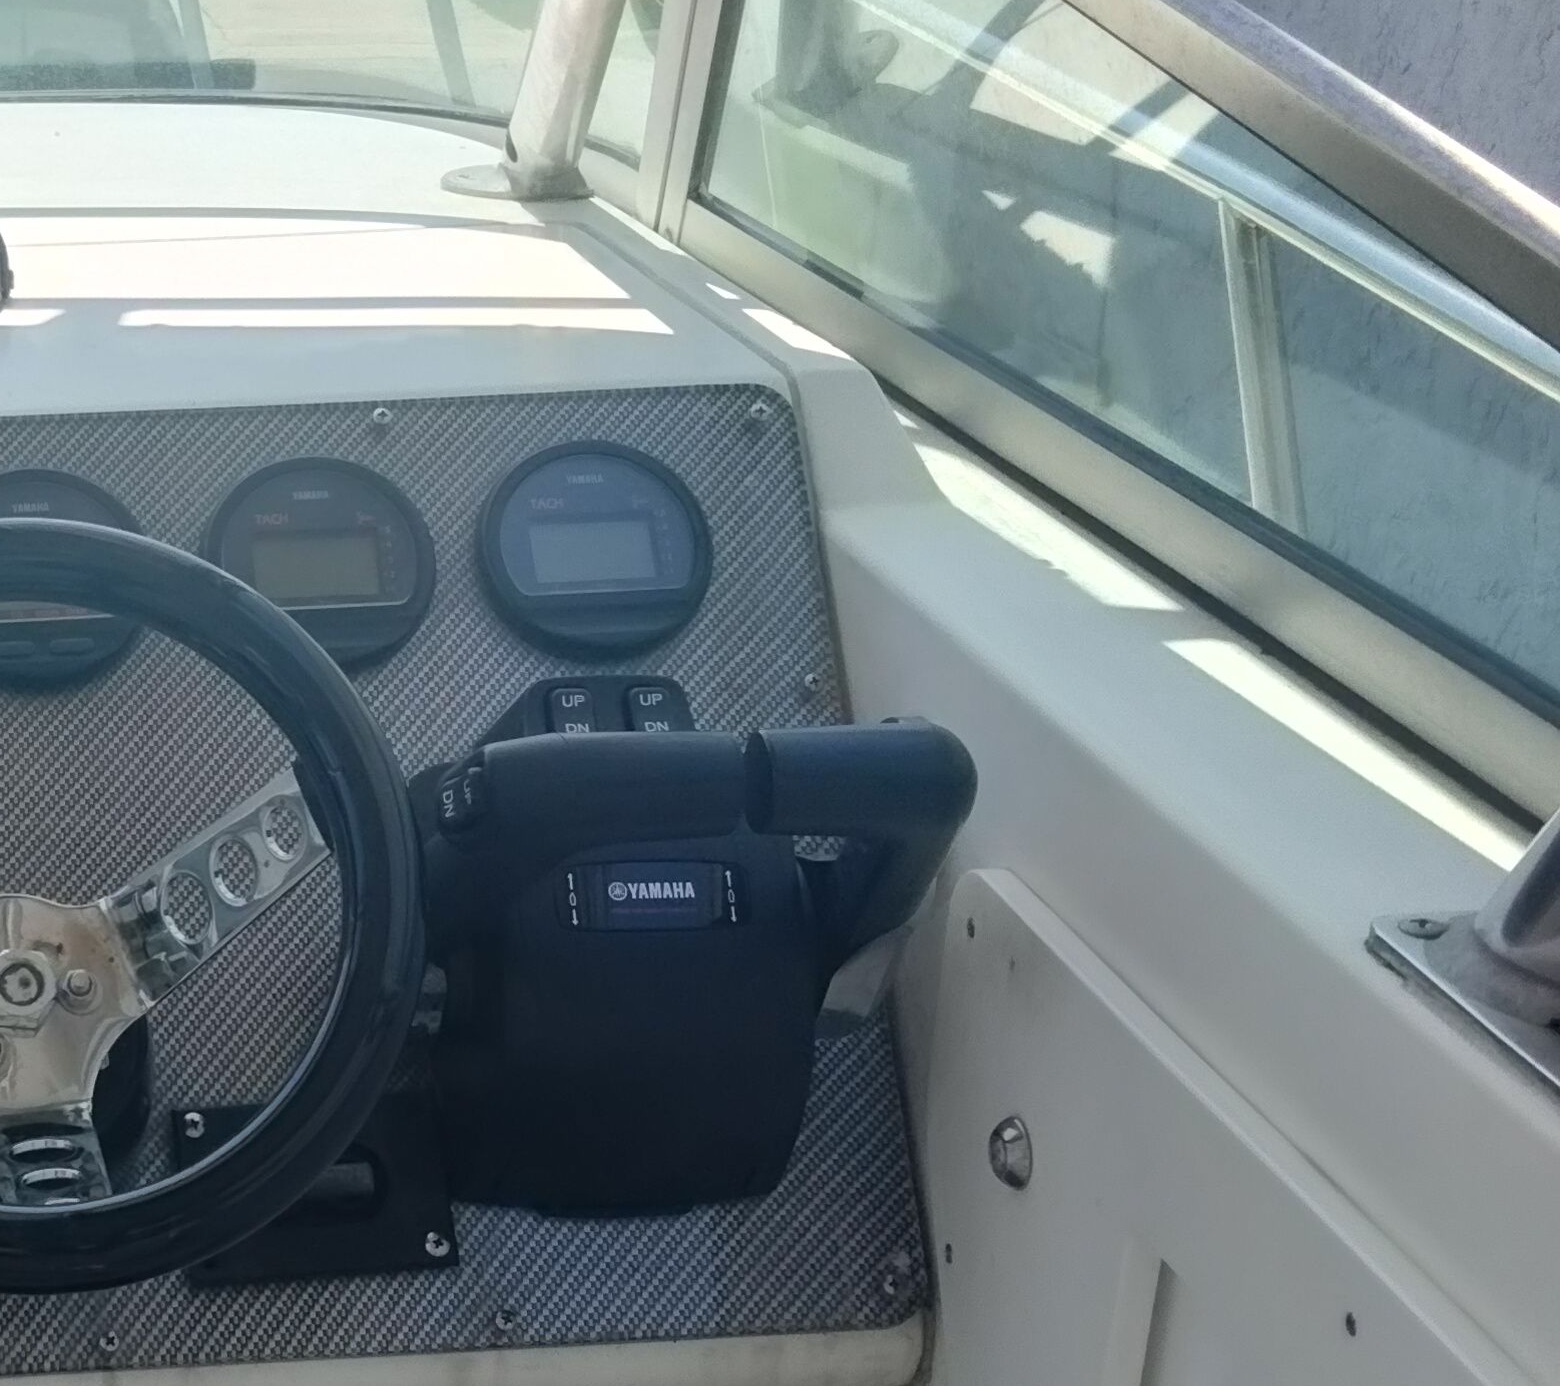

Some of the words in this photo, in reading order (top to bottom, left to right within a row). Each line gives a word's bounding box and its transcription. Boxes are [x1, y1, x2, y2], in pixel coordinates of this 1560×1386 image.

[561, 694, 586, 708] UP
[639, 693, 663, 706] UP
[565, 723, 590, 733] DN
[644, 721, 670, 732] DN
[442, 789, 456, 818] DN
[627, 881, 696, 900] YAMAHA
